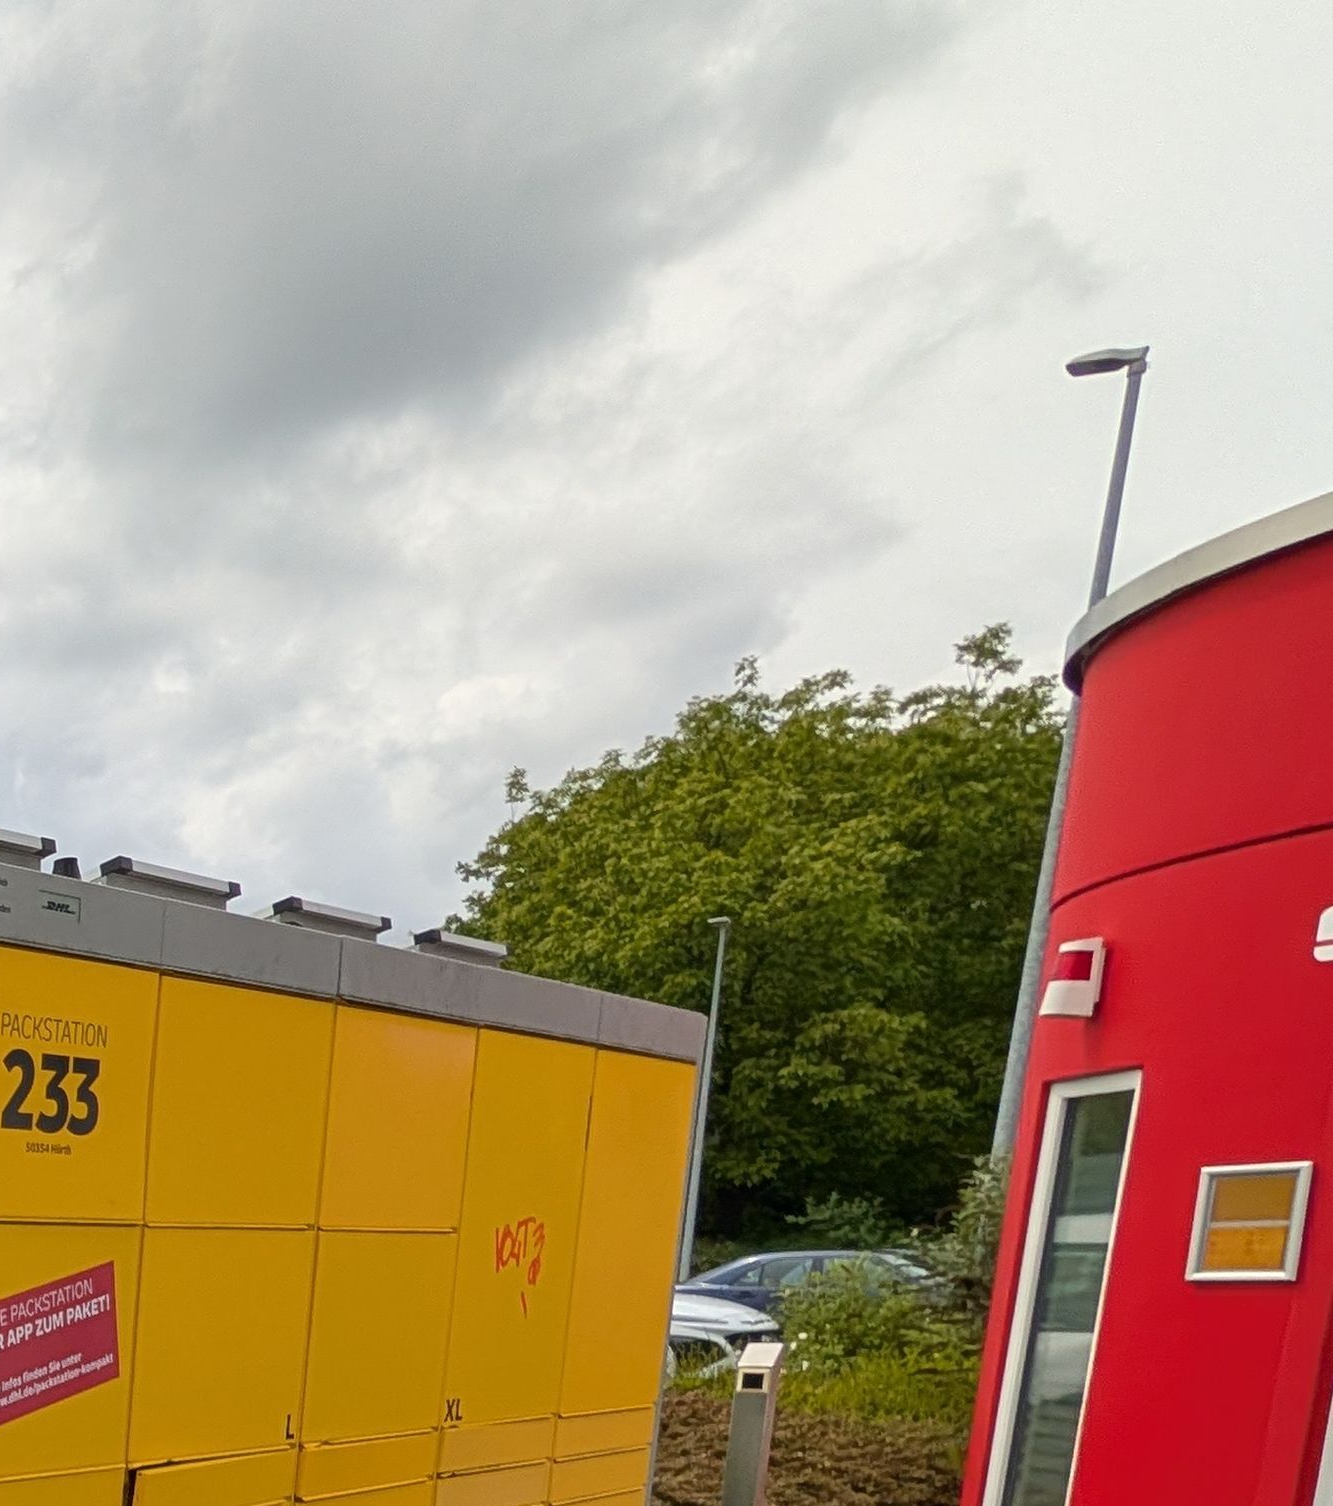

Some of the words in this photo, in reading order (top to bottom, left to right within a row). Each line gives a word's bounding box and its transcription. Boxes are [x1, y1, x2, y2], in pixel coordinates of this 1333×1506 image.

[41, 900, 76, 915] DHL
[0, 1012, 108, 1048] PACKSTATION
[0, 1048, 100, 1136] 233
[25, 1142, 49, 1153] 50354
[10, 1277, 93, 1323] PACKSTATION
[7, 1323, 33, 1348] APP
[35, 1311, 64, 1337] ZUM
[66, 1293, 110, 1326] PAKET!
[1, 1375, 22, 1392] Infos
[22, 1366, 48, 1383] finden
[48, 1360, 61, 1374] Sie
[61, 1352, 82, 1369] unter
[285, 1414, 294, 1440] L
[444, 1398, 463, 1423] XL
